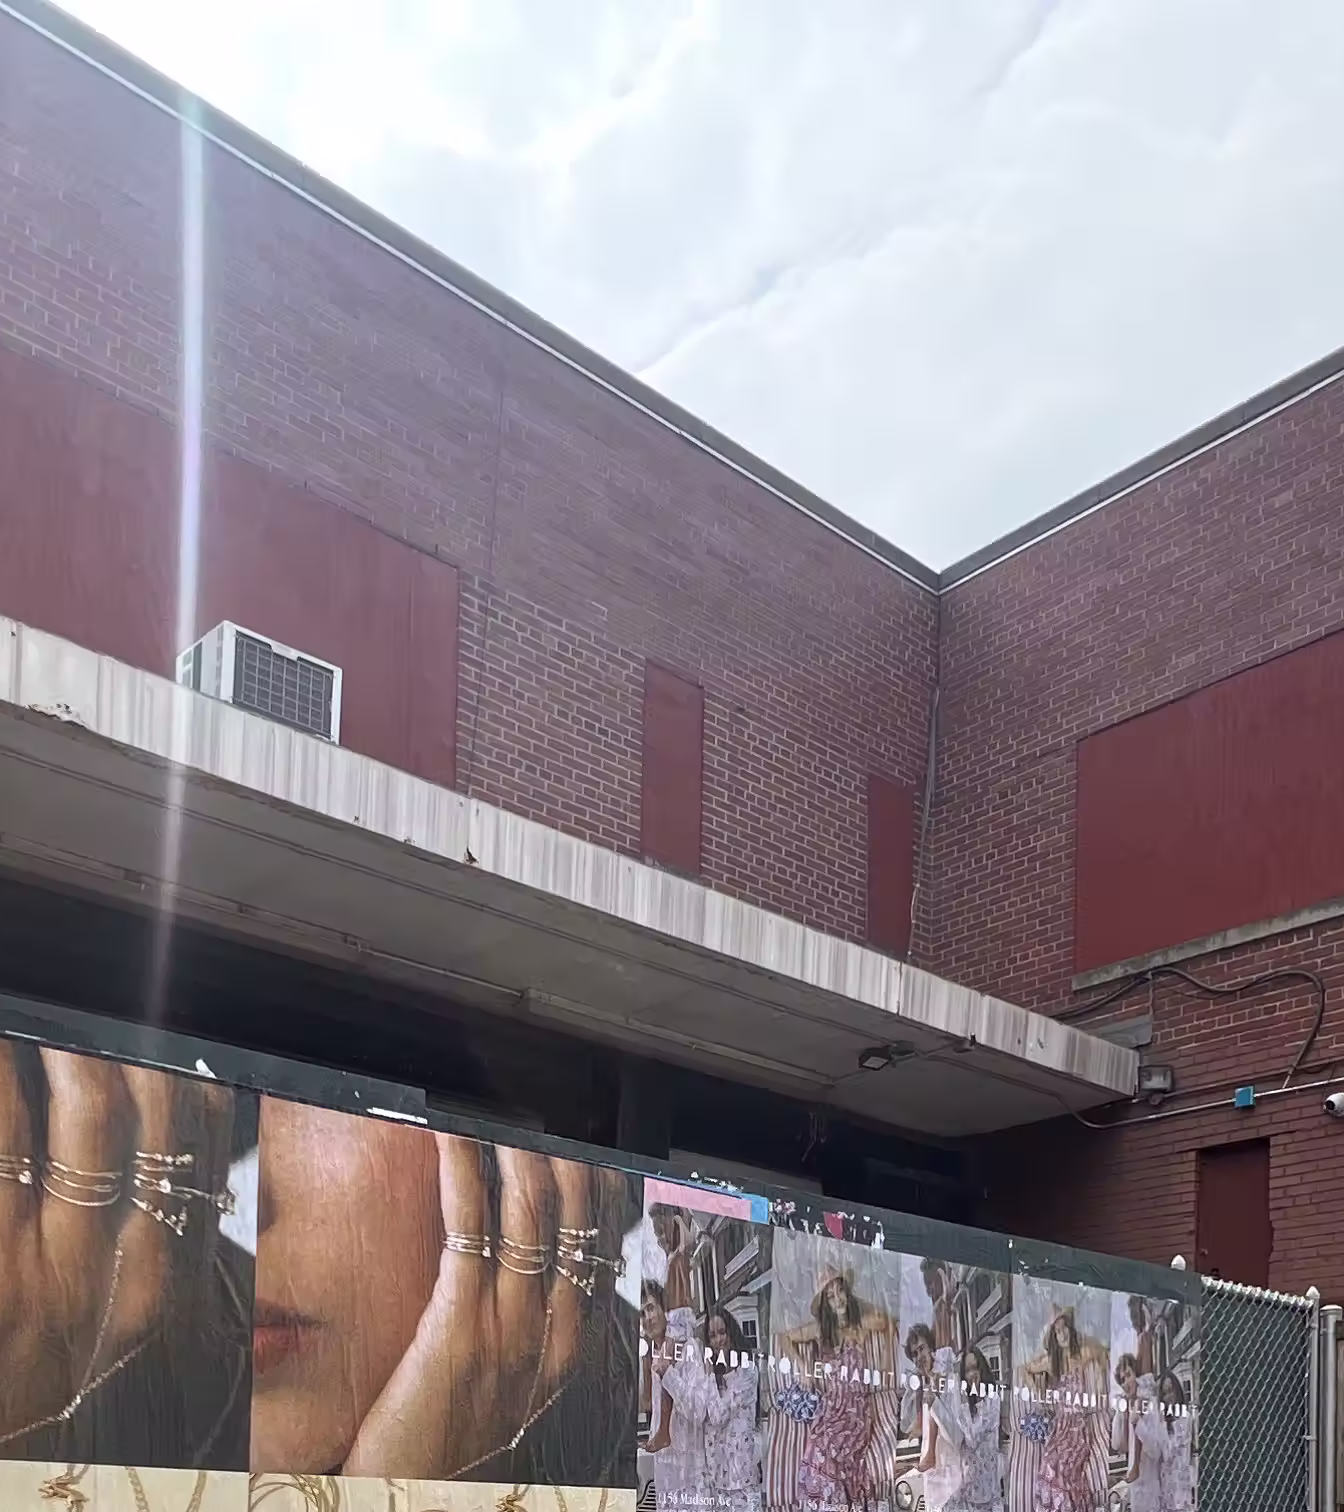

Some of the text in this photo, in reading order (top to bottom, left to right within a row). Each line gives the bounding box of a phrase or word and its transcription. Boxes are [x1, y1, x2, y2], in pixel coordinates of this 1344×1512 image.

[638, 1338, 764, 1371] OLLER RABBIT
[767, 1354, 895, 1387] ROLLER RABBIT
[900, 1372, 1007, 1402] ROLLER RABBIT
